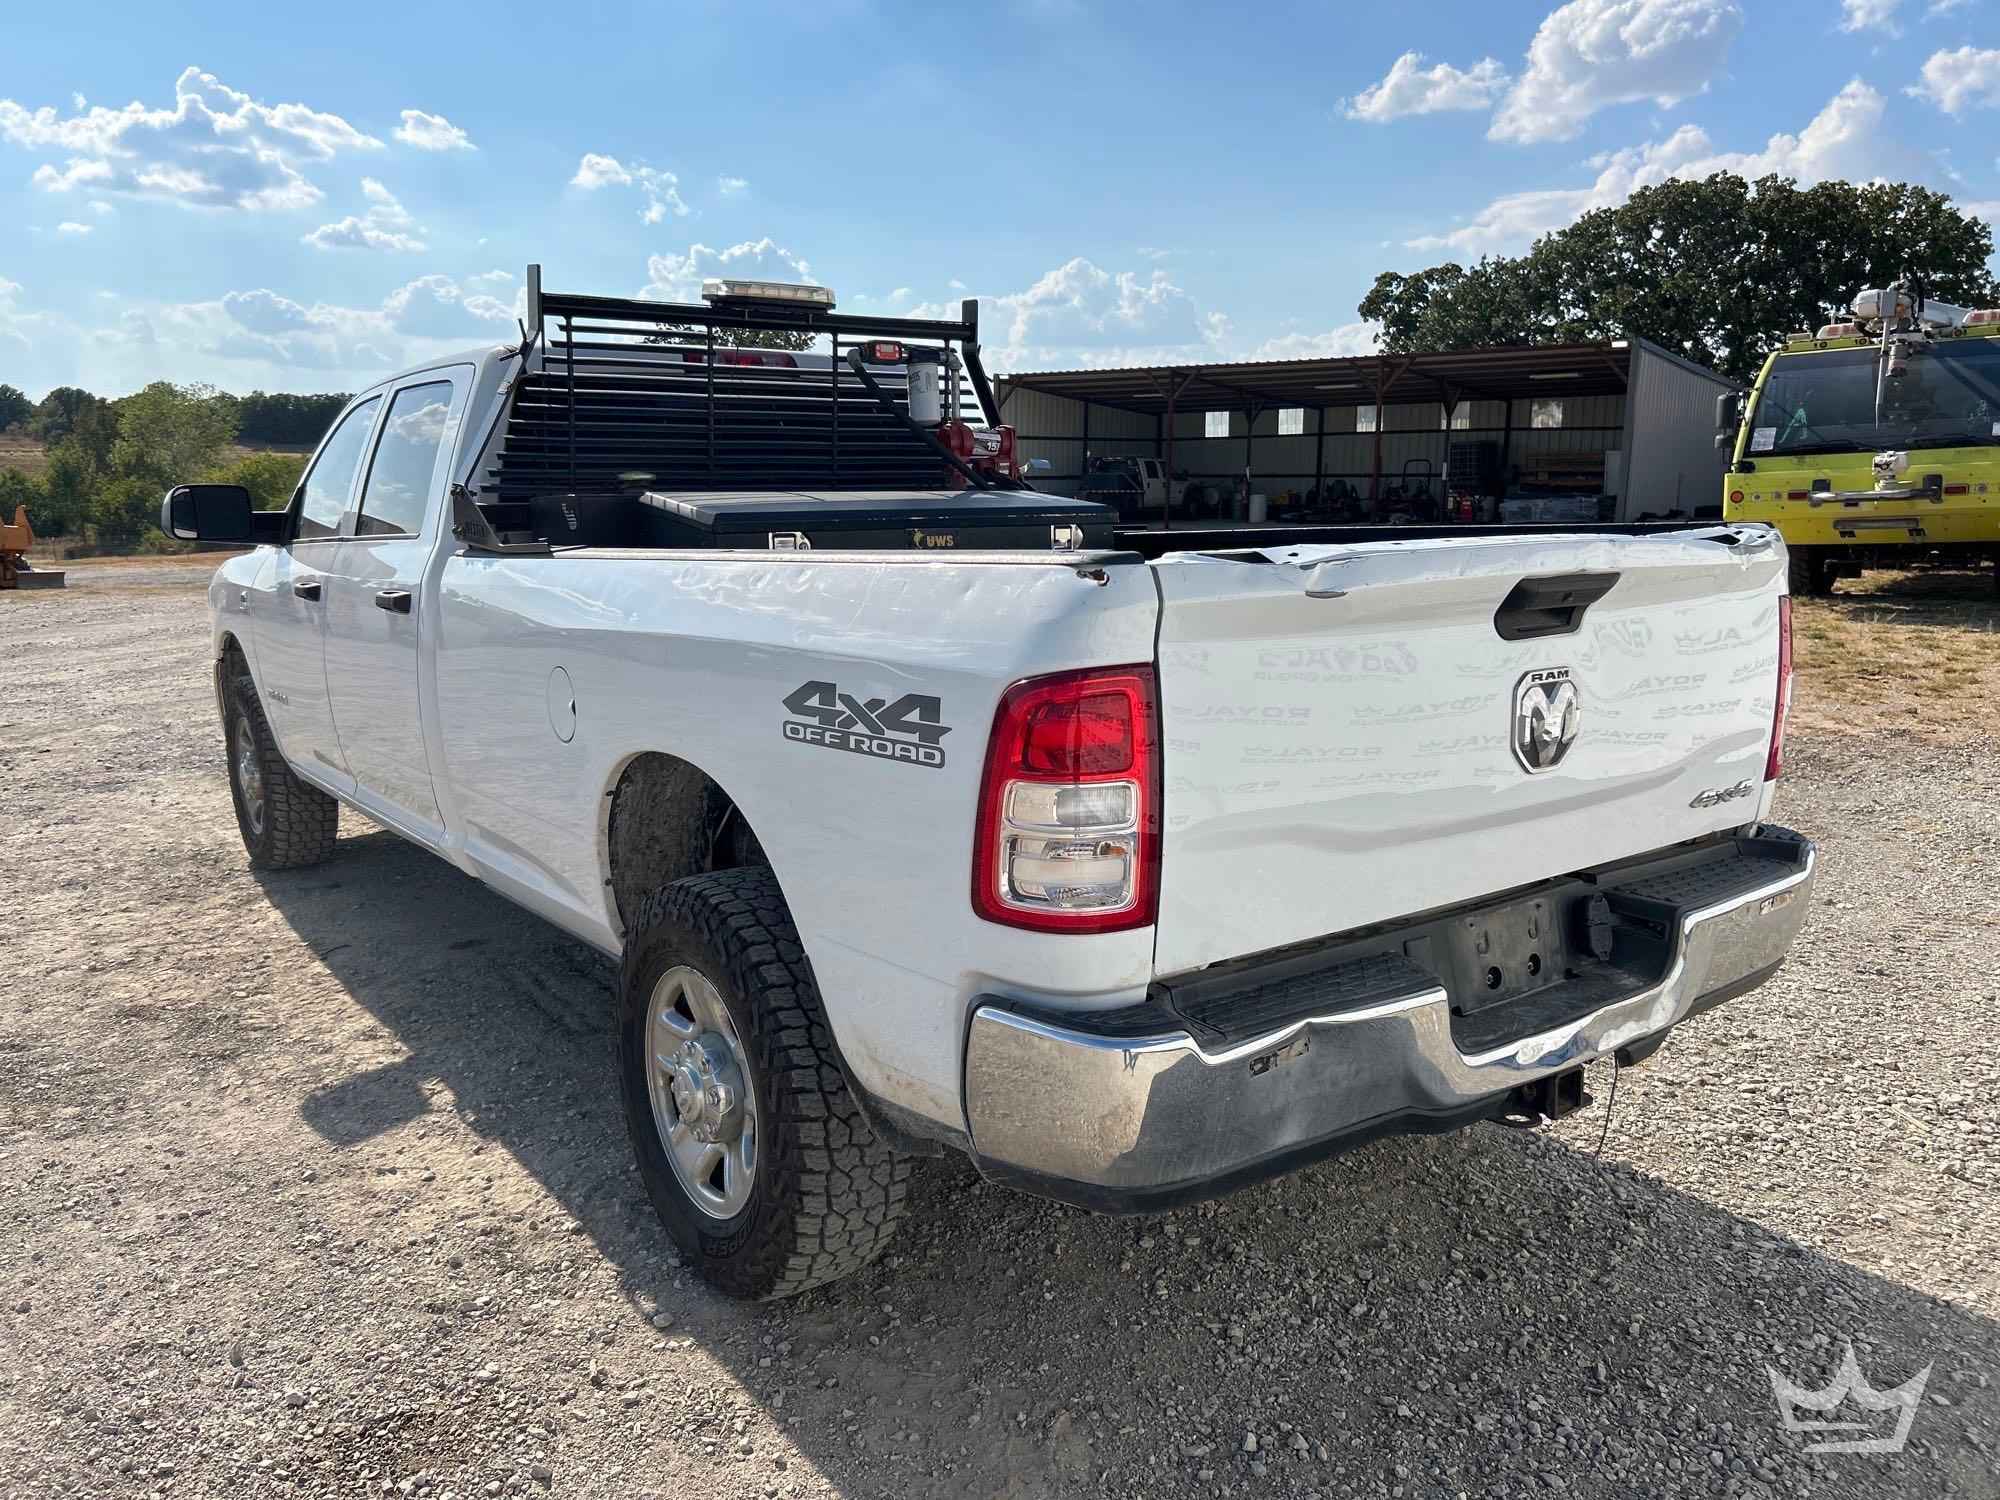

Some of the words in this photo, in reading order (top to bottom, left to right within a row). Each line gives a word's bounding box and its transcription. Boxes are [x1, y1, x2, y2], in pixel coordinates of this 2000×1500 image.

[927, 535, 954, 547] UWS
[1531, 670, 1570, 682] RAM
[785, 723, 842, 745] OFF
[849, 735, 942, 764] ROAD
